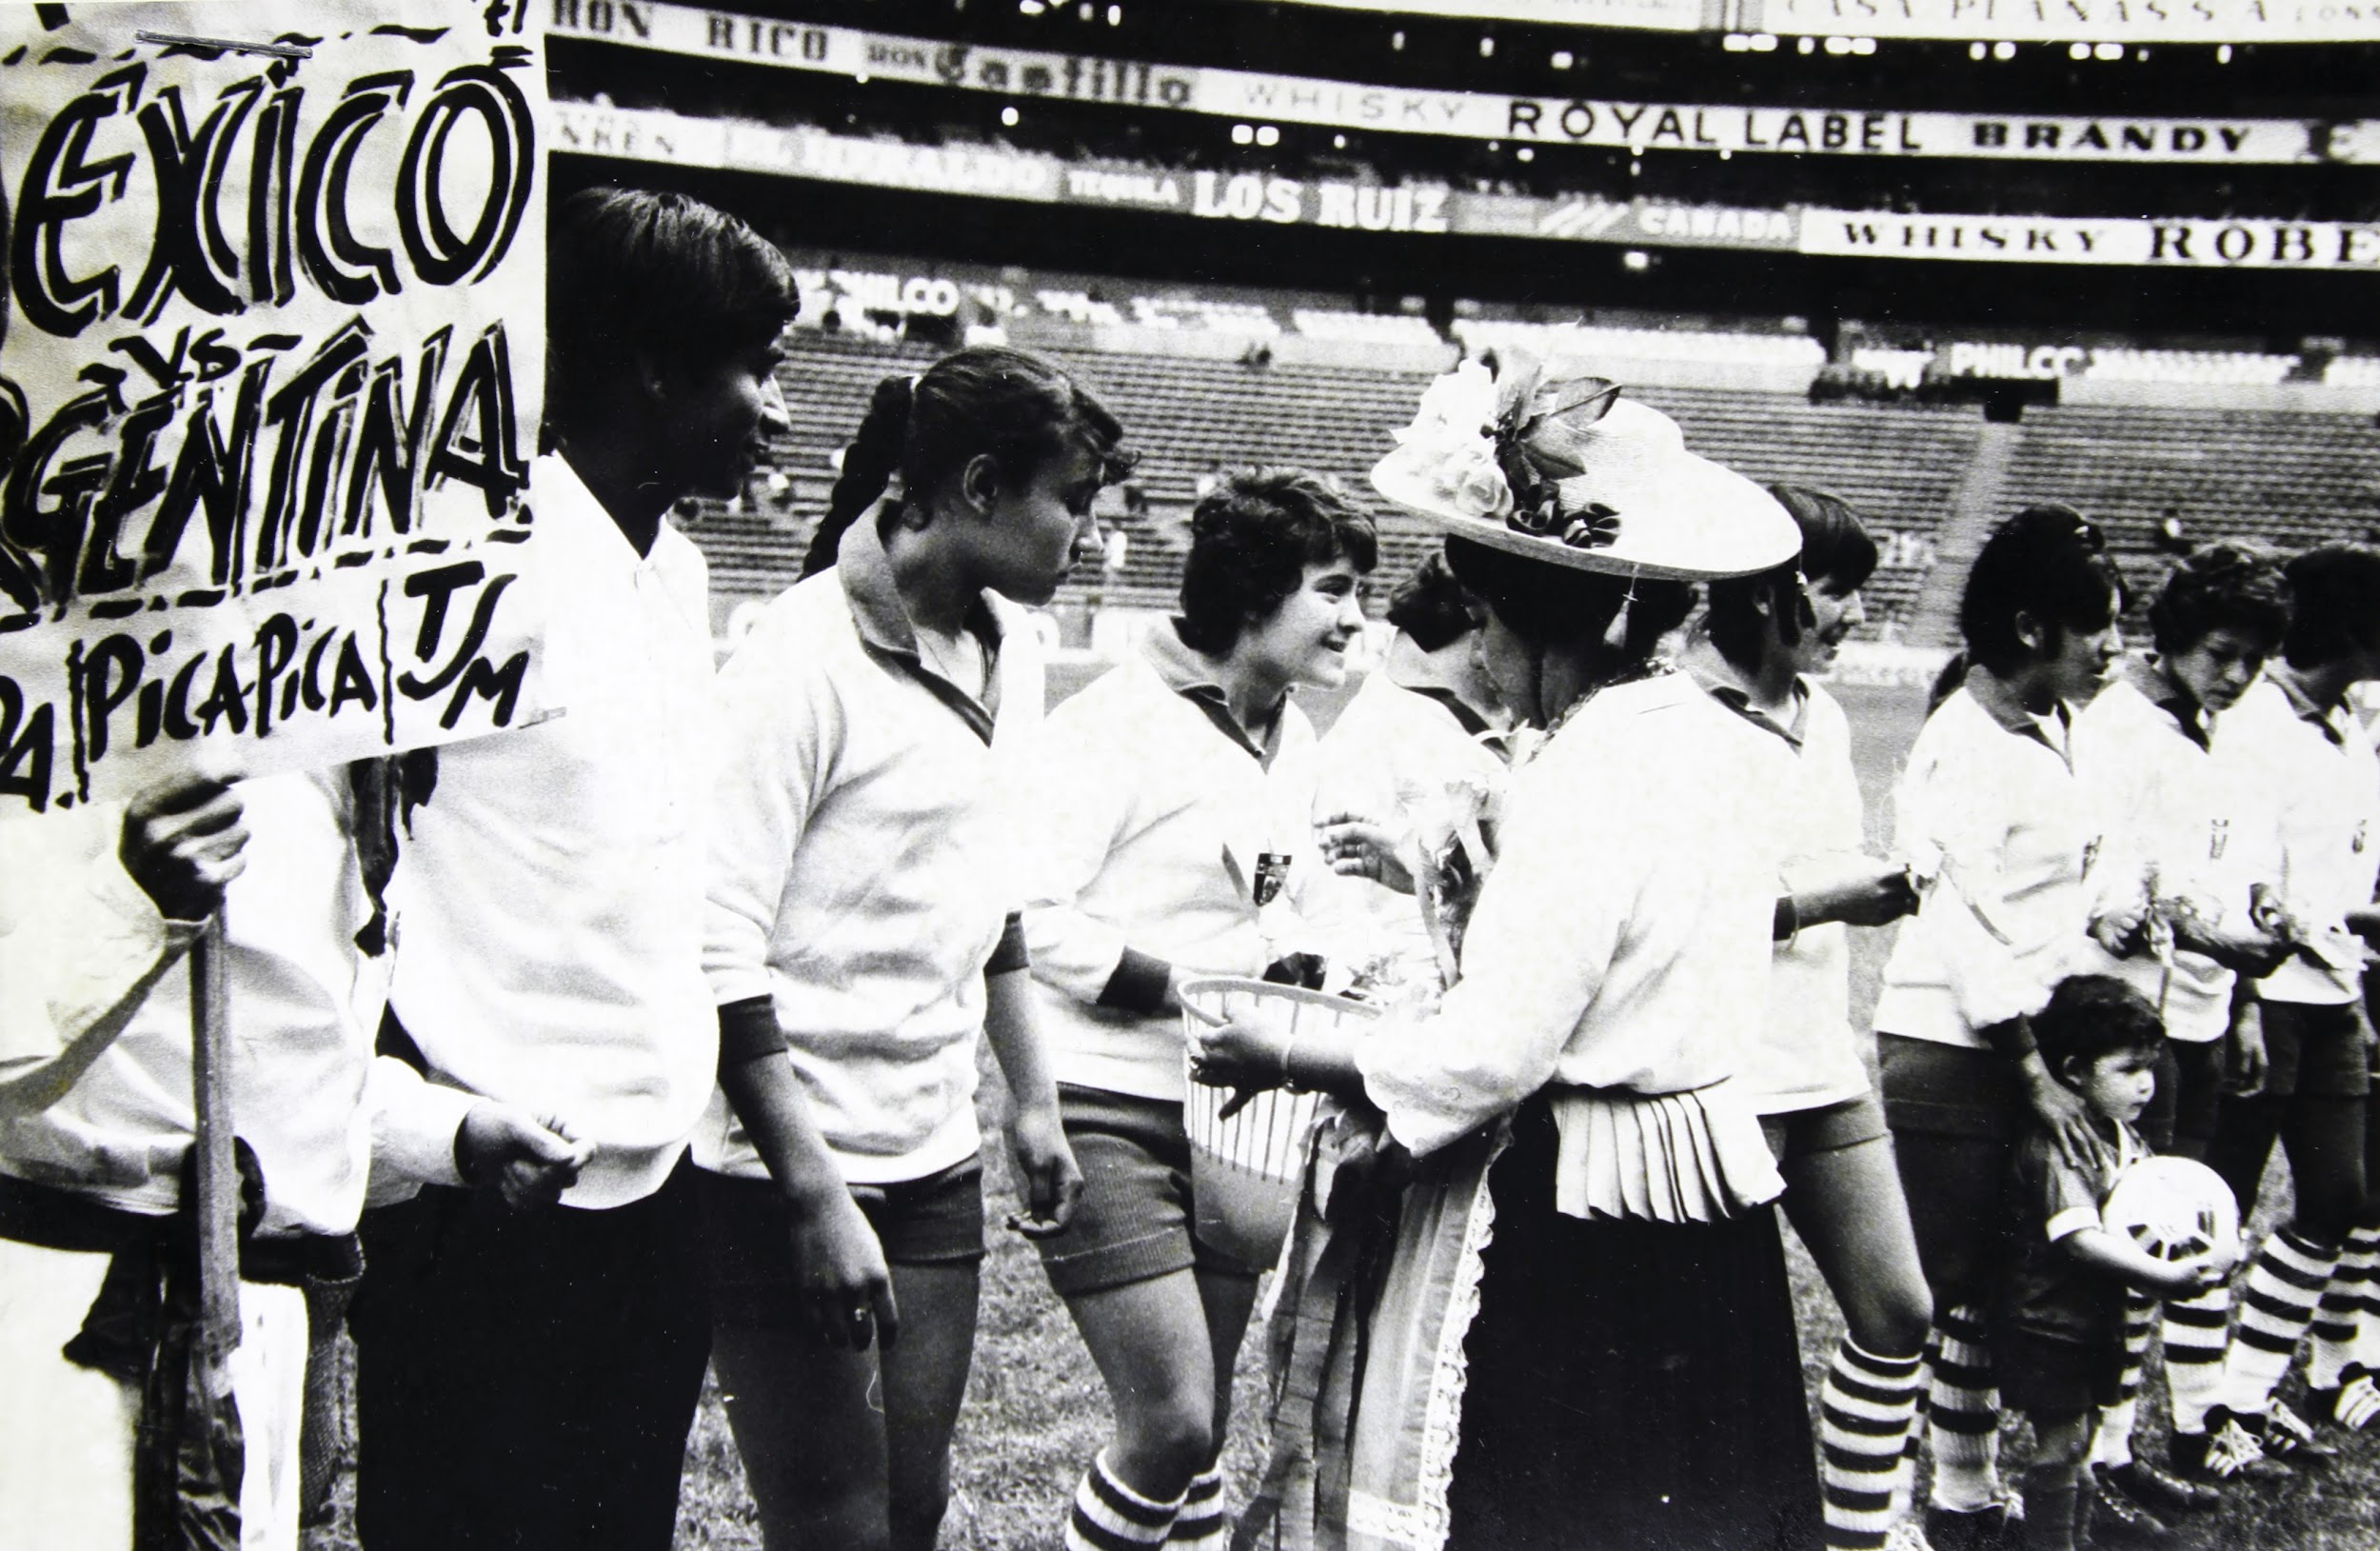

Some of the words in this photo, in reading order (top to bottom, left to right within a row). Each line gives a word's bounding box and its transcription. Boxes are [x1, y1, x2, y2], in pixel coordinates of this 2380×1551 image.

[707, 15, 829, 61] RICO
[1244, 81, 1464, 124] WHISKY
[1508, 101, 1717, 144] ROYAL
[1746, 112, 1922, 150] LABEL
[1973, 122, 2250, 152] BRANDY
[0, 62, 534, 339] EXICO
[1193, 170, 1304, 224] LOS
[1318, 182, 1449, 232] RUIZ
[1636, 206, 1793, 241] CANADA
[1843, 220, 2097, 251] WHISKY
[1950, 342, 2086, 379] PHILCO
